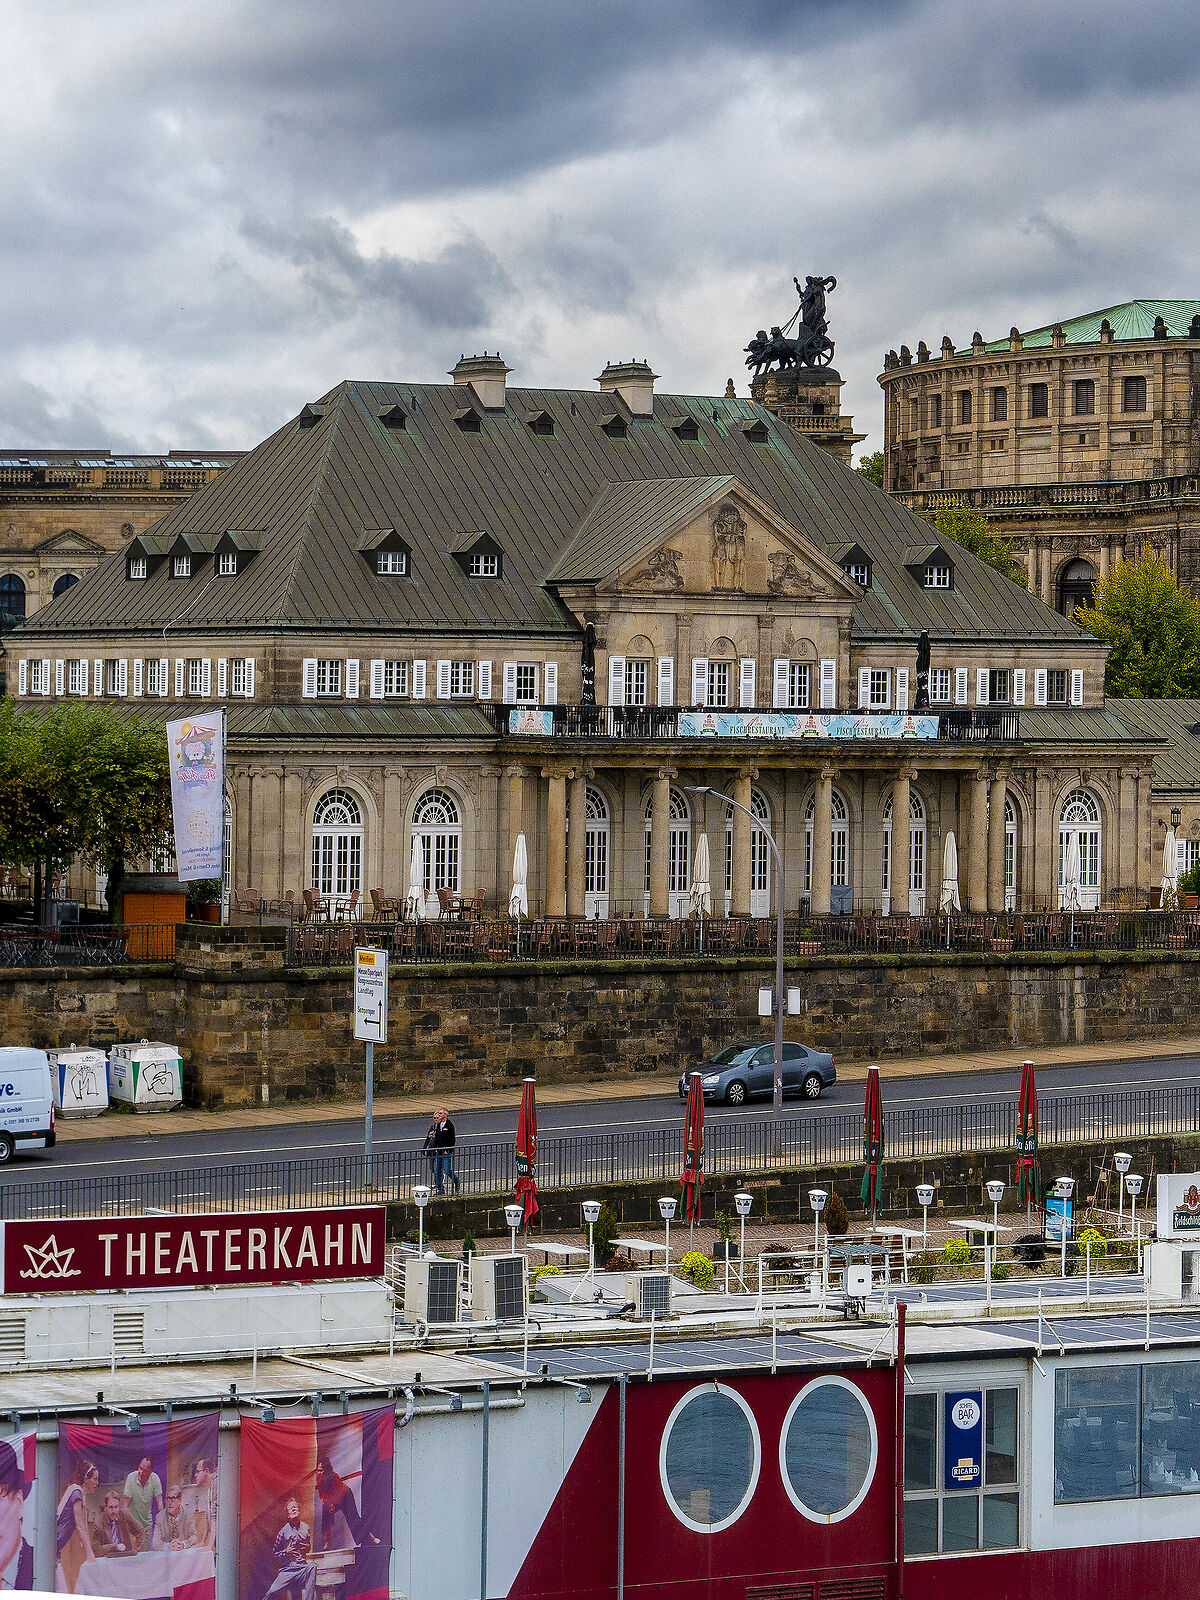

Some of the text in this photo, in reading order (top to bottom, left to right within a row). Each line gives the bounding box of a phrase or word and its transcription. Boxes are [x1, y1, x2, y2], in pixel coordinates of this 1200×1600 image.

[729, 726, 785, 735] FISCHRESTAURANT
[98, 1222, 372, 1277] THEATERKAHN
[958, 1409, 974, 1420] BAR
[954, 1467, 978, 1475] RICARD
